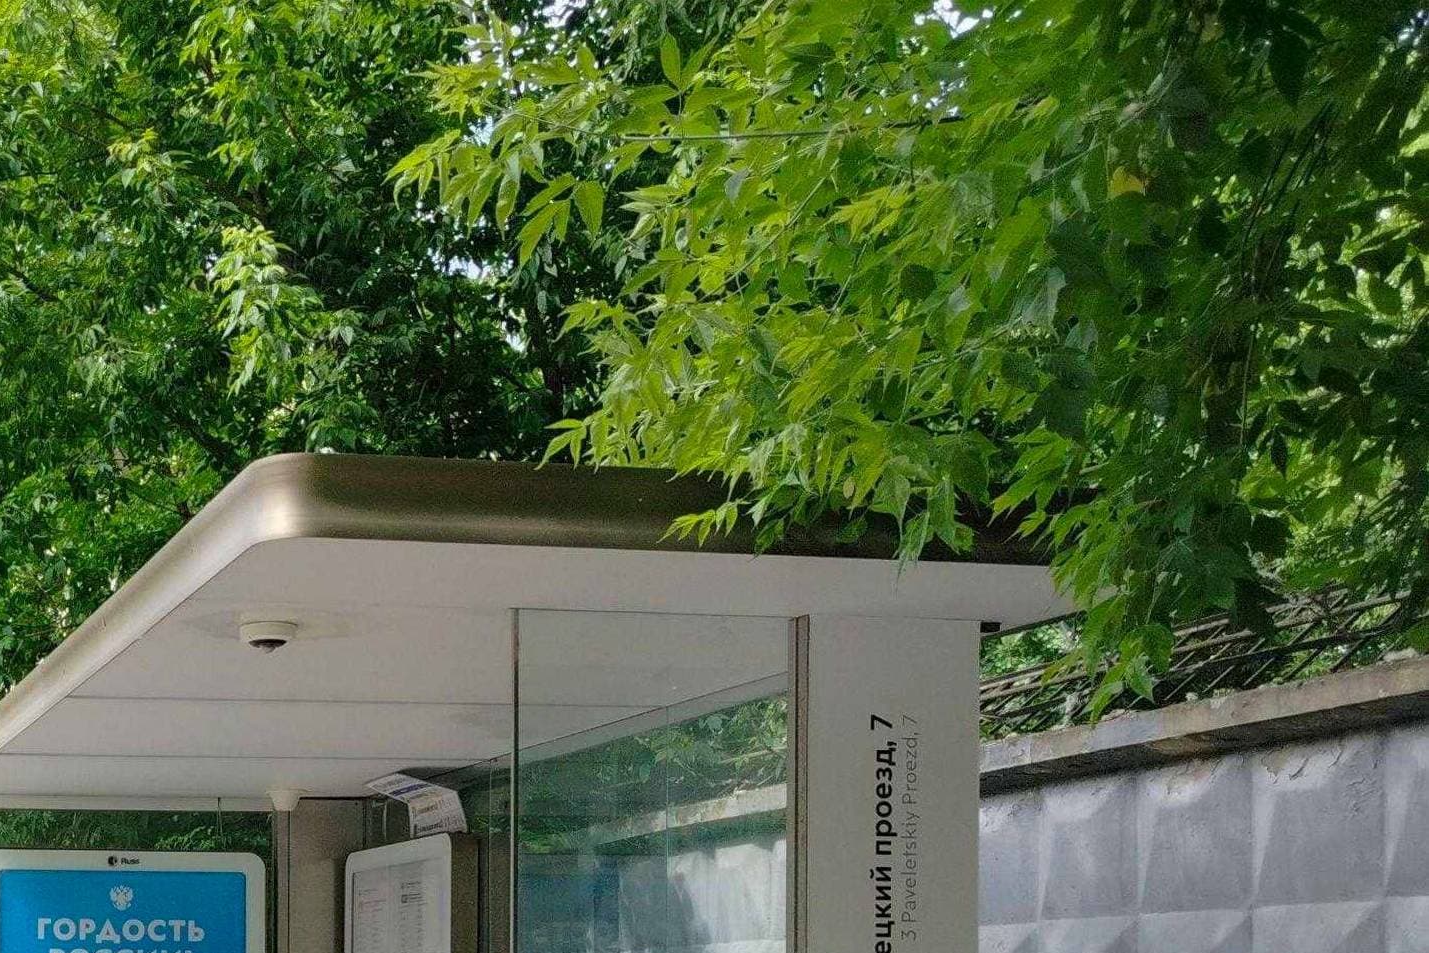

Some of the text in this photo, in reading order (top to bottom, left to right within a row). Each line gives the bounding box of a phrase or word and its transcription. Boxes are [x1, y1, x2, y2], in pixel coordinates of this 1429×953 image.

[870, 713, 894, 731] 7
[875, 740, 898, 856] проезд,
[900, 714, 921, 942] 3 Paveletskiy Proezd, 7
[37, 917, 206, 945] ГОРДОСТЬ
